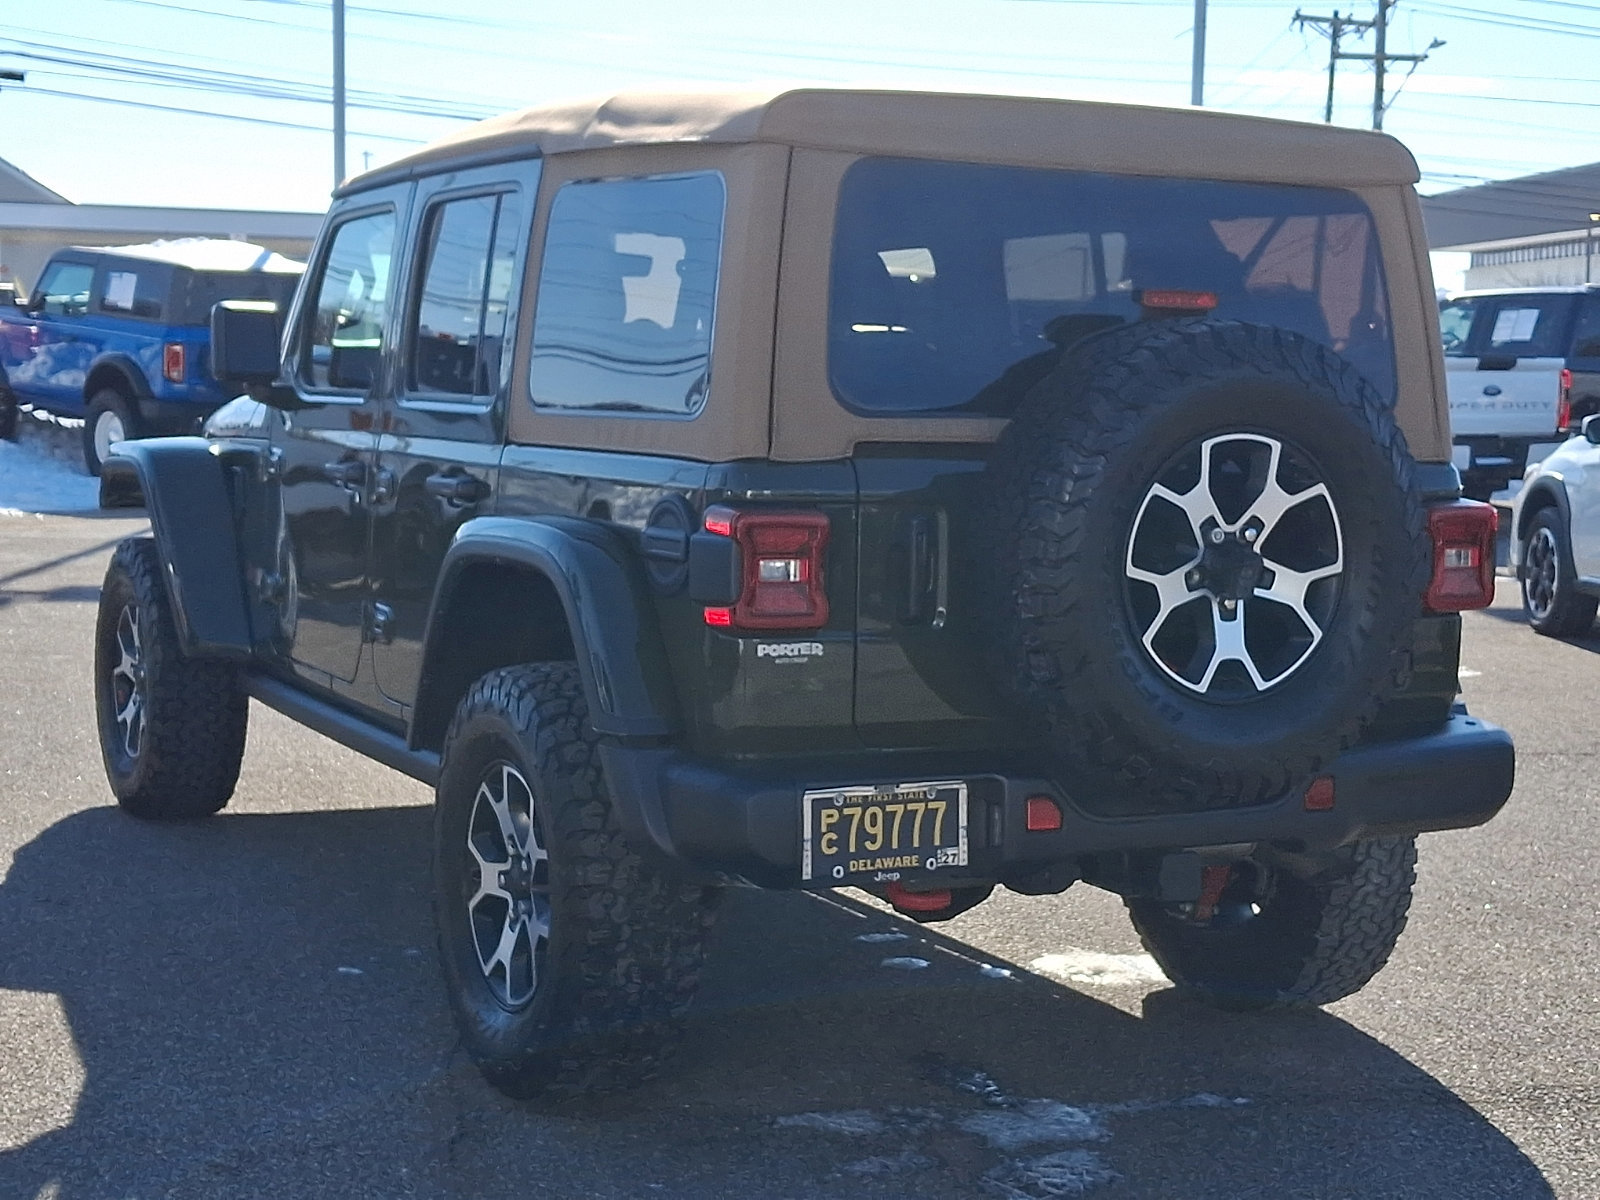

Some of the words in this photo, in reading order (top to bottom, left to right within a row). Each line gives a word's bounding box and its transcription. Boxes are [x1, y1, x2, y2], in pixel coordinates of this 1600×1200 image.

[1450, 401, 1496, 410] PER
[757, 642, 823, 657] PORTER
[897, 790, 925, 800] STATE
[843, 801, 947, 853] 79777
[850, 855, 919, 871] DELAWARE
[943, 853, 957, 864] 27
[874, 872, 900, 881] Jeep
